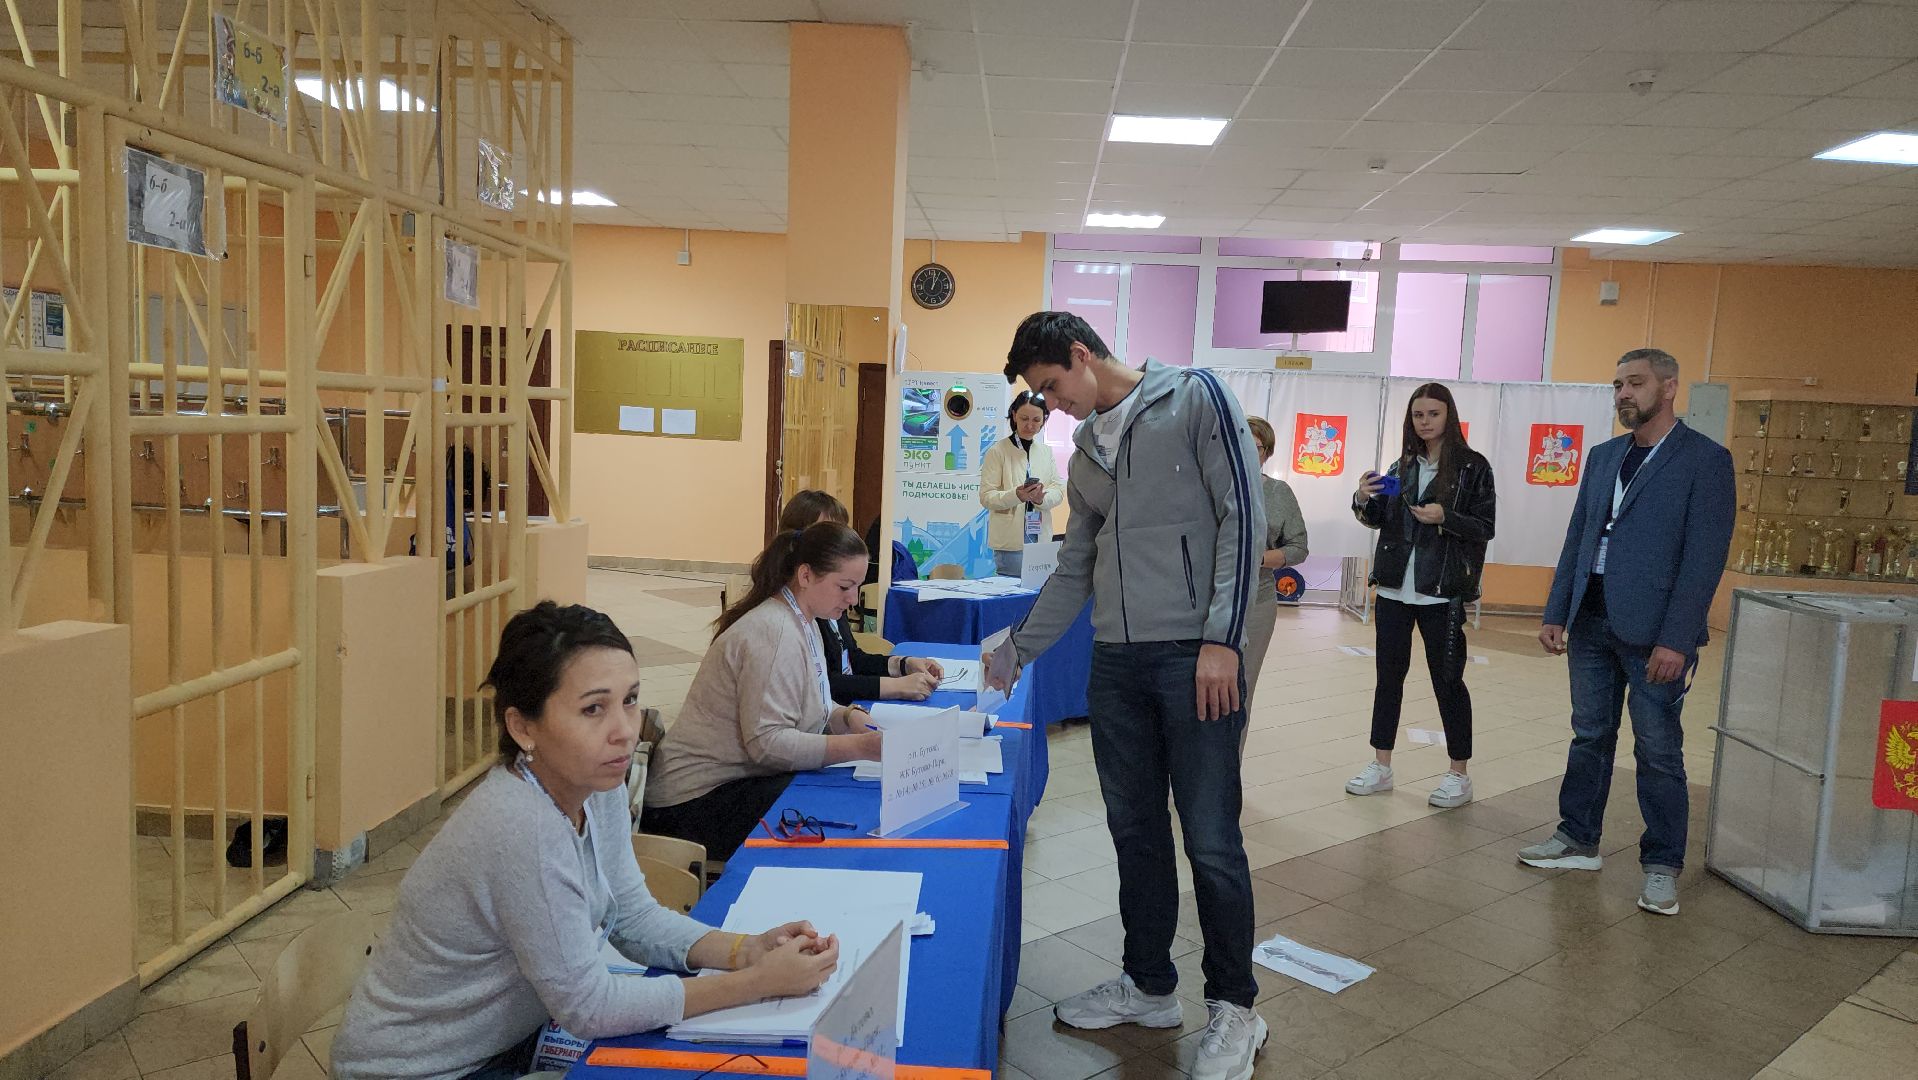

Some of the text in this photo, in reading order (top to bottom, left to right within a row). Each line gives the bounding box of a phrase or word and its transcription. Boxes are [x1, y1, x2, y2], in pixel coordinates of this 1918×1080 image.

[243, 41, 263, 65] 6-б
[261, 75, 280, 98] 2-а
[149, 174, 168, 194] 6-б
[617, 338, 719, 356] РАСПИСАНИЕ
[903, 449, 932, 461] ЭКО
[902, 480, 981, 492] ТЫ ДЕЛАЕШЬ ЧИСТ
[902, 490, 969, 501] ПОДМОСКОВЬЕ!
[544, 1036, 585, 1048] ВЫБОРЫ
[541, 1045, 582, 1058] ГУБЕРНАТО
